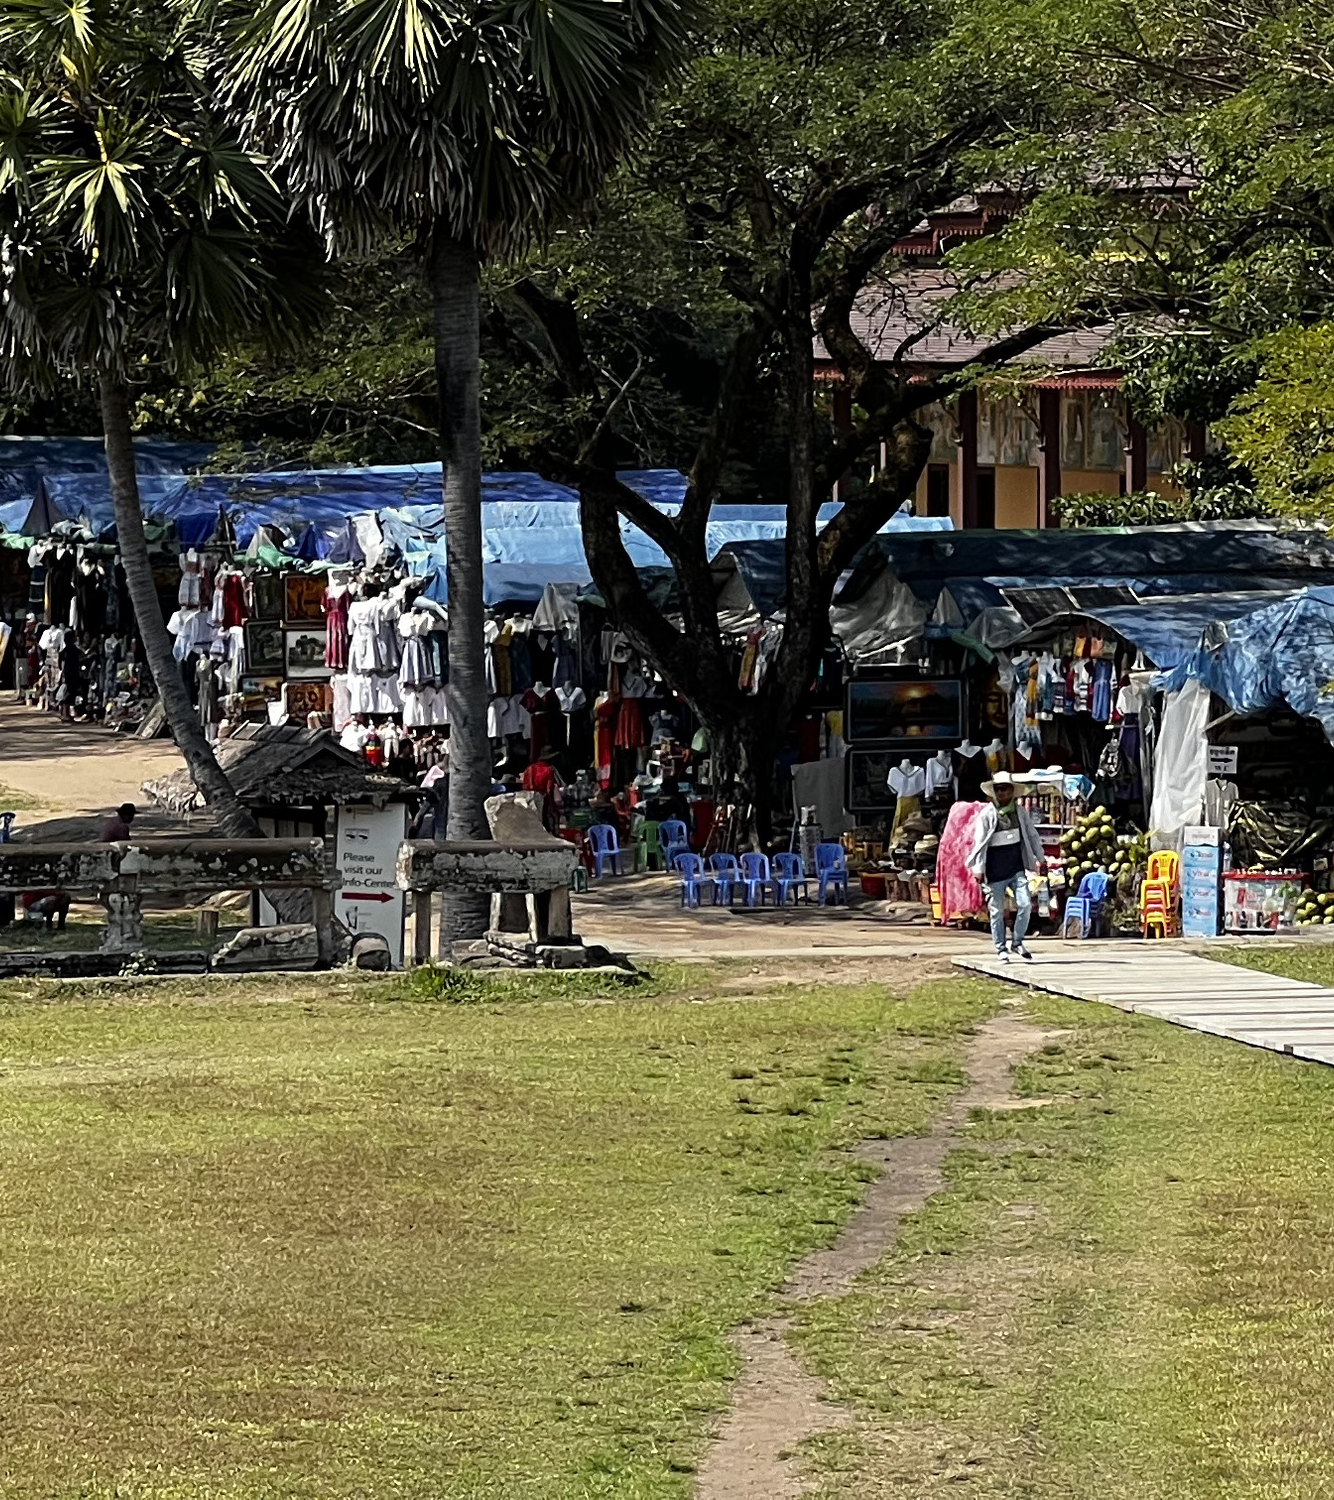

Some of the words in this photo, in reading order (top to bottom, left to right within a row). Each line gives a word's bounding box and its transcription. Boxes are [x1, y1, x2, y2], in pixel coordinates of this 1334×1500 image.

[343, 852, 375, 862] Please
[343, 865, 364, 875] visit
[365, 867, 384, 875] our
